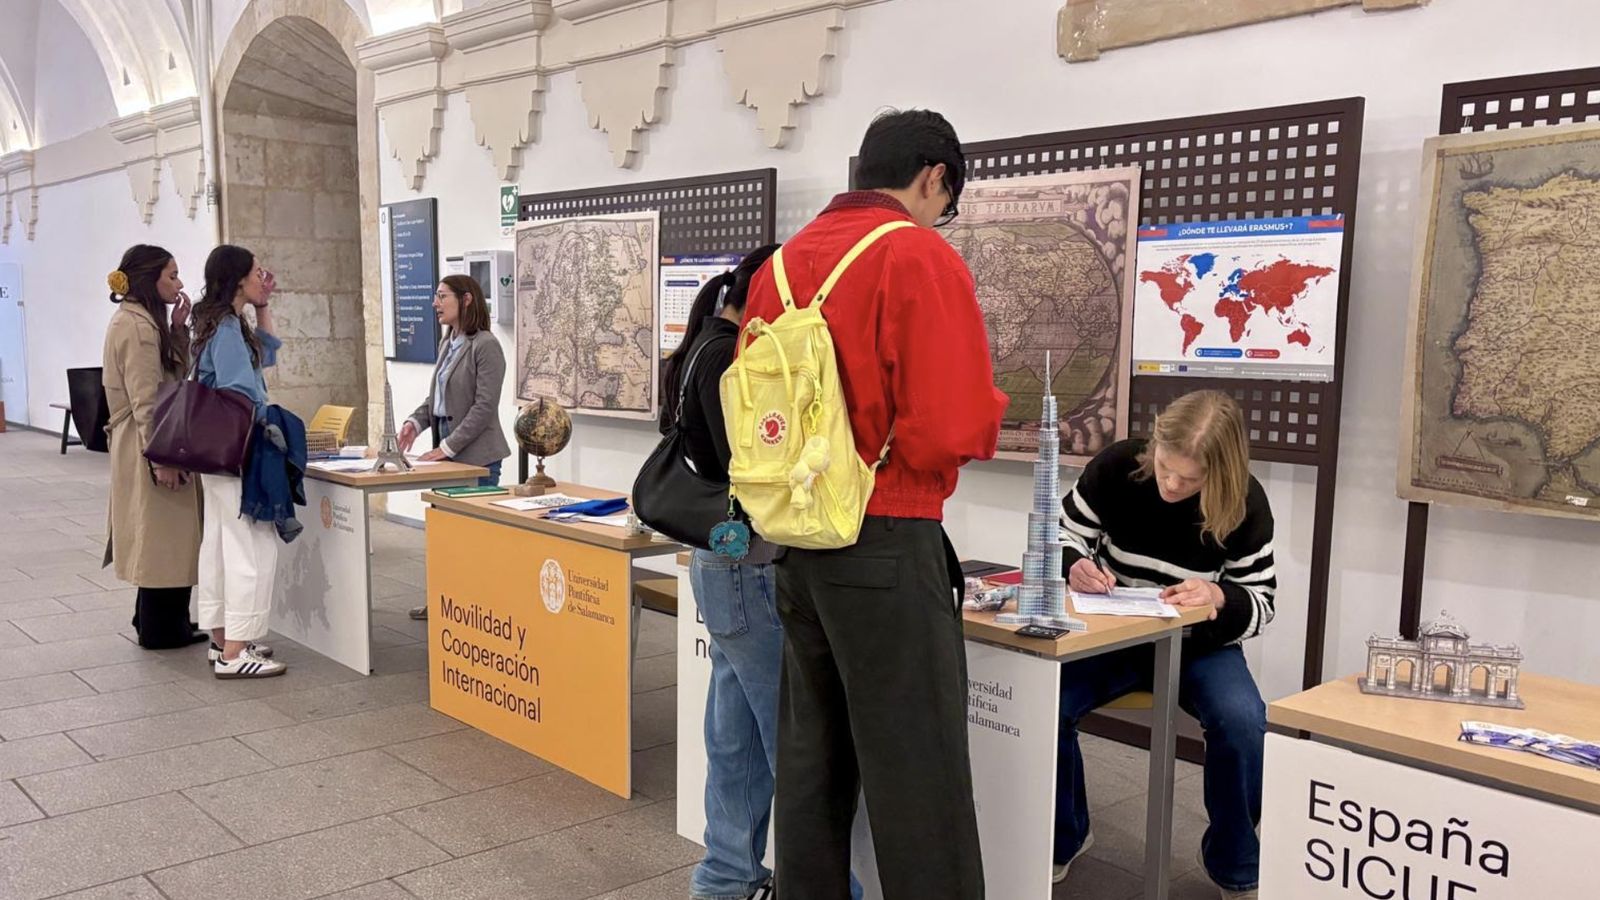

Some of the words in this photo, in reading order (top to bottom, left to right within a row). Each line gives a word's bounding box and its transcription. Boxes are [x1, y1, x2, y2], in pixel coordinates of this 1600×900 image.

[960, 203, 977, 216] BIS
[1178, 226, 1206, 237] ¿DÓNDE
[1206, 226, 1216, 234] TE
[1216, 224, 1248, 234] LLEVARÁ
[567, 568, 609, 592] Universidad
[568, 584, 600, 606] Pontificia
[440, 594, 512, 641] Movilidad
[517, 625, 527, 651] y
[567, 600, 577, 613] de
[577, 602, 615, 626] Salamanca
[441, 628, 540, 687] Cooperación
[442, 660, 541, 723] Internacional
[968, 679, 1013, 701] versidad
[968, 694, 999, 714] tificia
[968, 711, 1021, 738] alamanca
[1308, 779, 1510, 878] España
